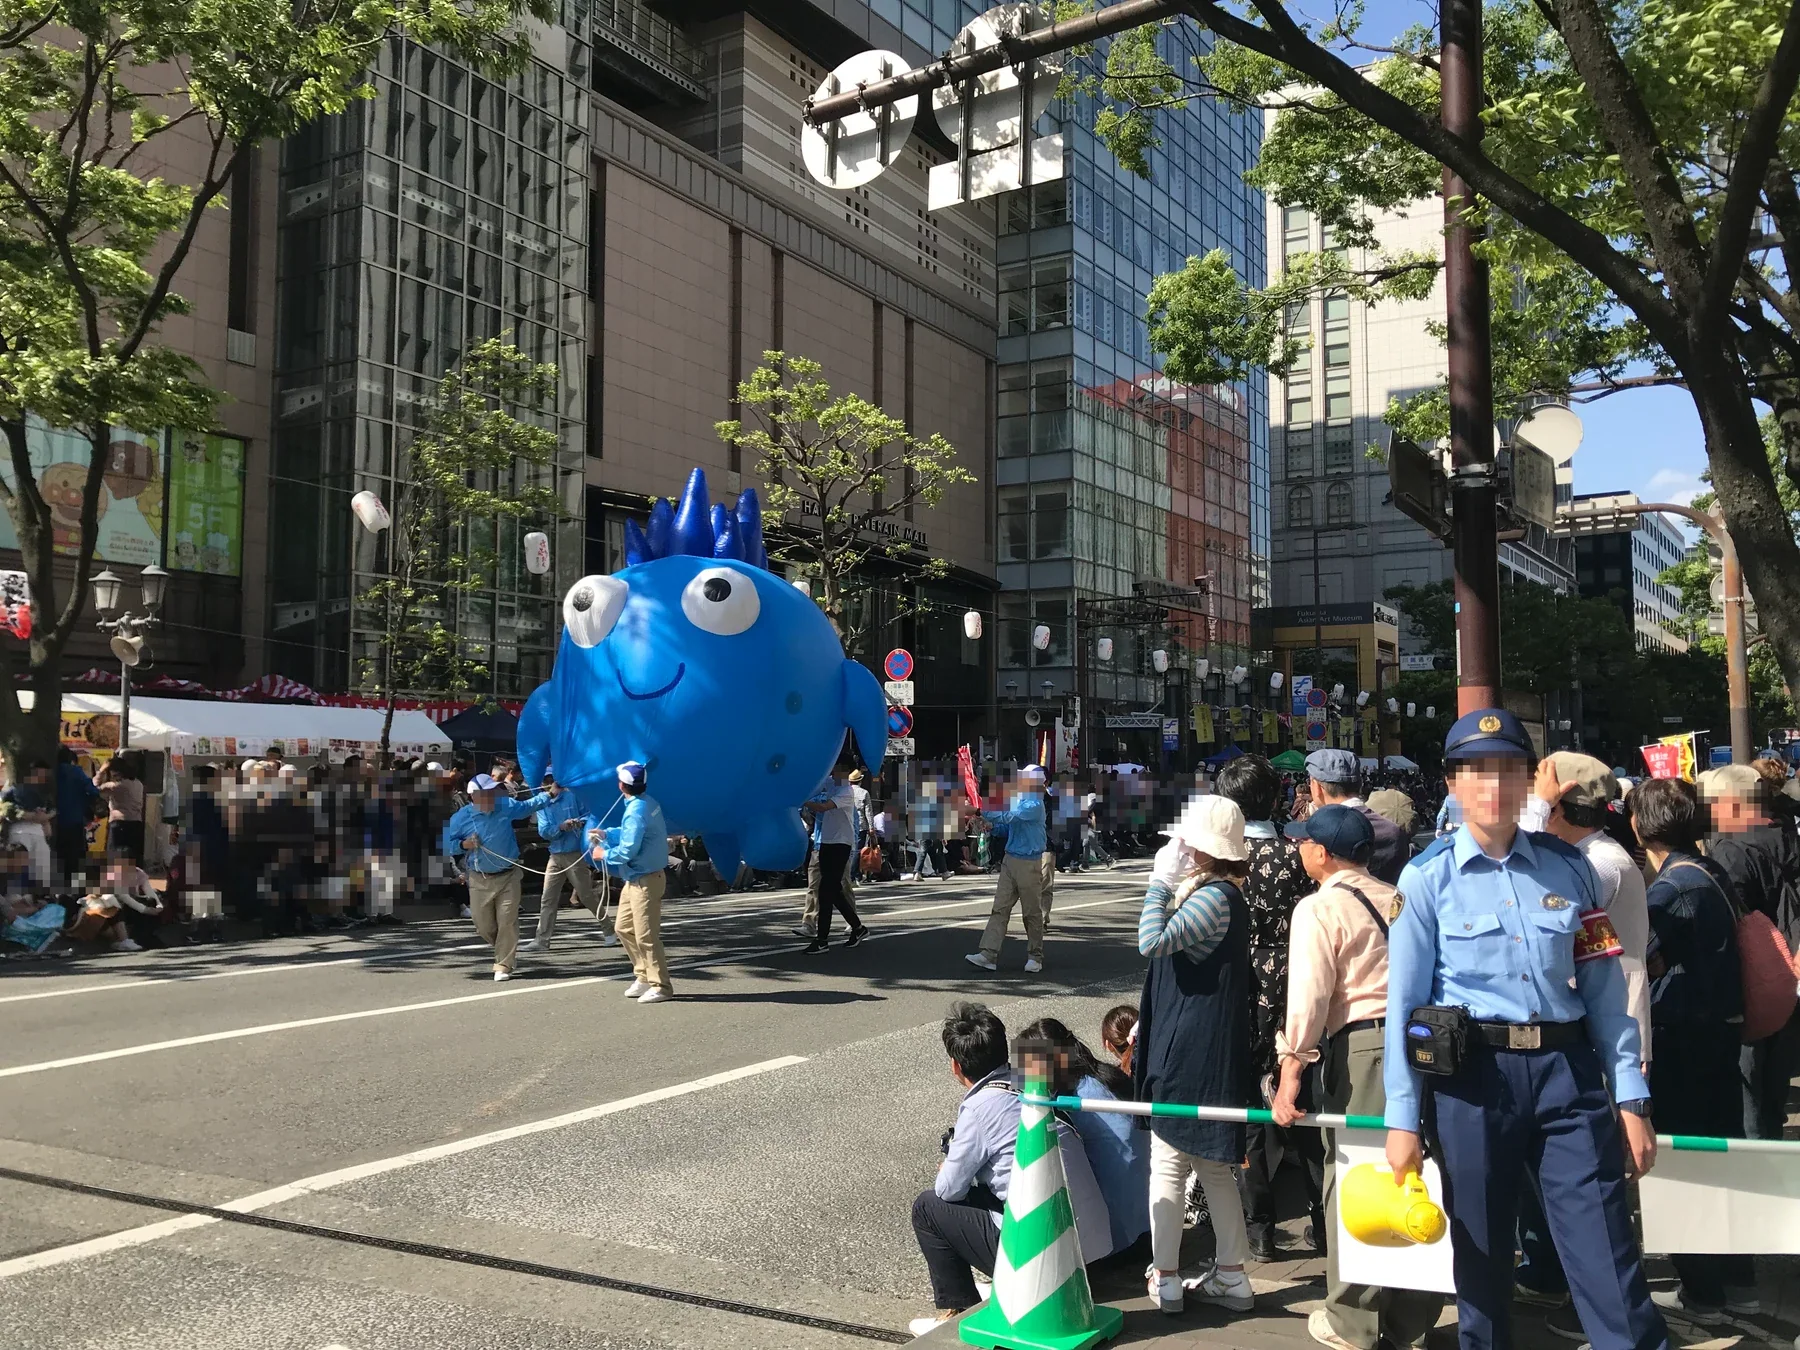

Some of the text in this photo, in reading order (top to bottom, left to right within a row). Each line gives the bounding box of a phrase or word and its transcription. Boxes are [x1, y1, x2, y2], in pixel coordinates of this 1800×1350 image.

[189, 502, 222, 530] 5F
[852, 513, 900, 537] RVERAIN
[904, 527, 928, 544] MALL
